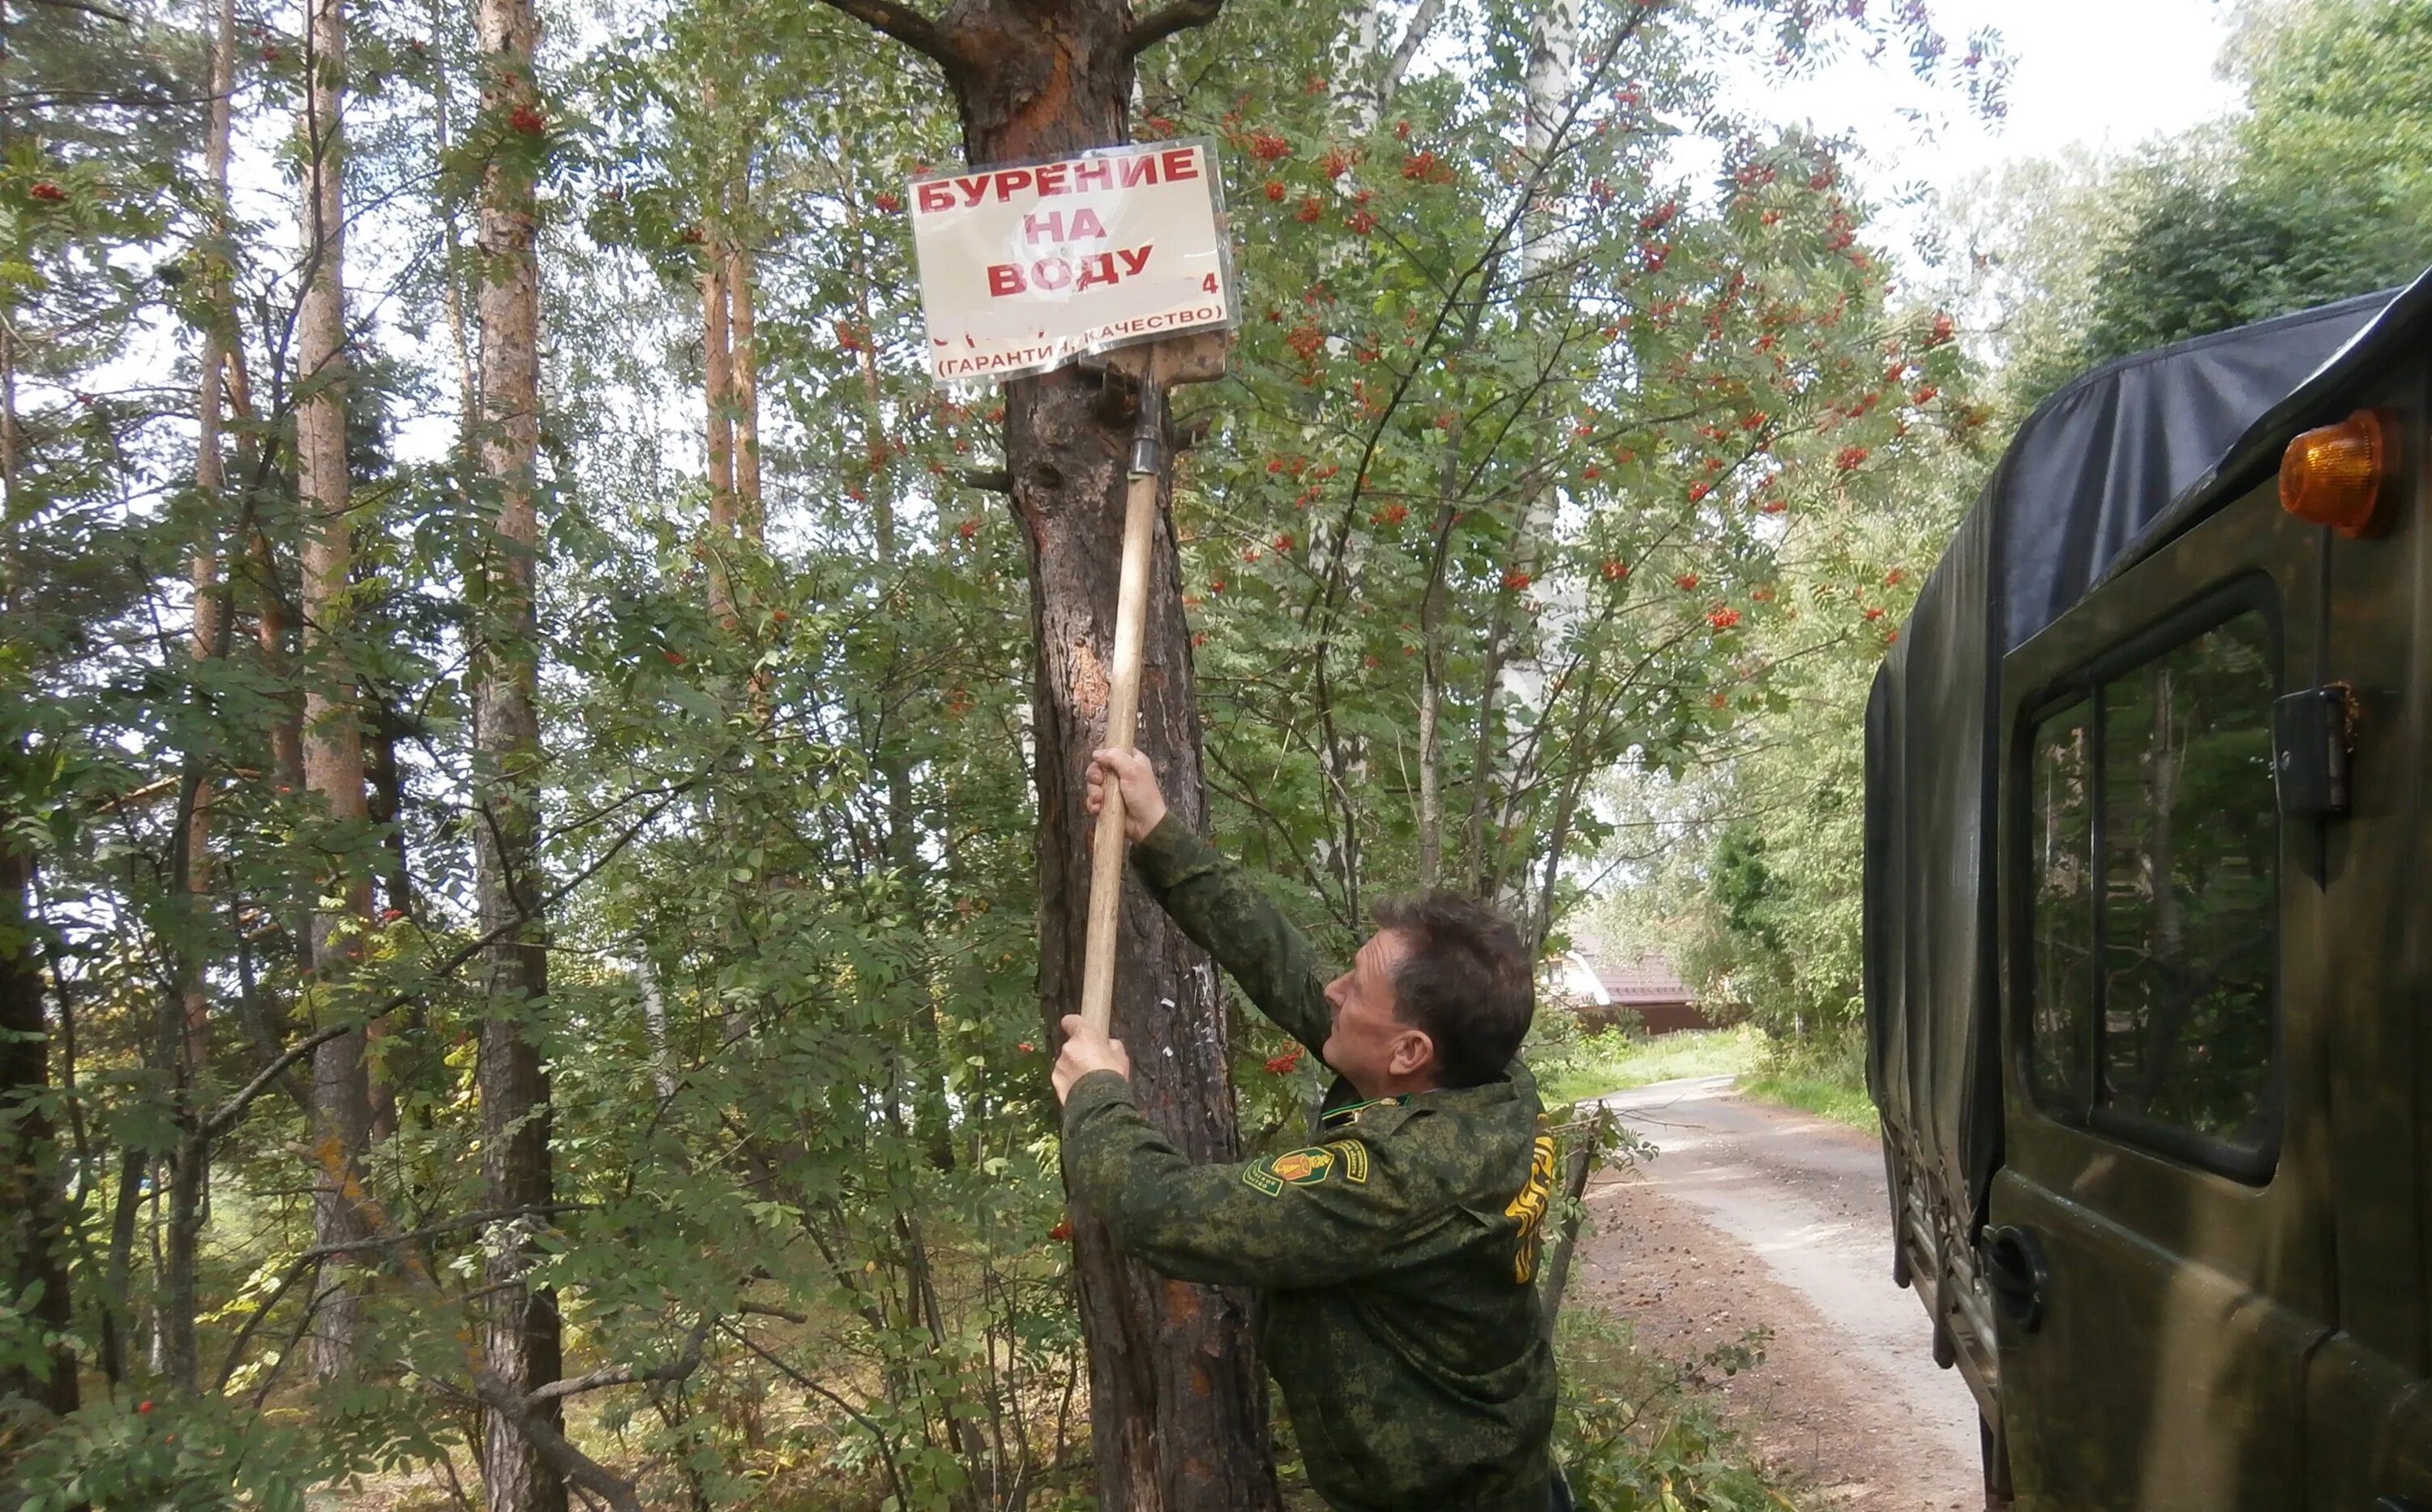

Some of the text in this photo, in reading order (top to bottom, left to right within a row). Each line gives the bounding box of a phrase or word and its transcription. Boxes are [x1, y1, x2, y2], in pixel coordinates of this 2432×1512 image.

[918, 148, 1199, 214] БУРЕНИЕ
[1024, 208, 1107, 245] НА
[987, 245, 1154, 298] ВОДУ
